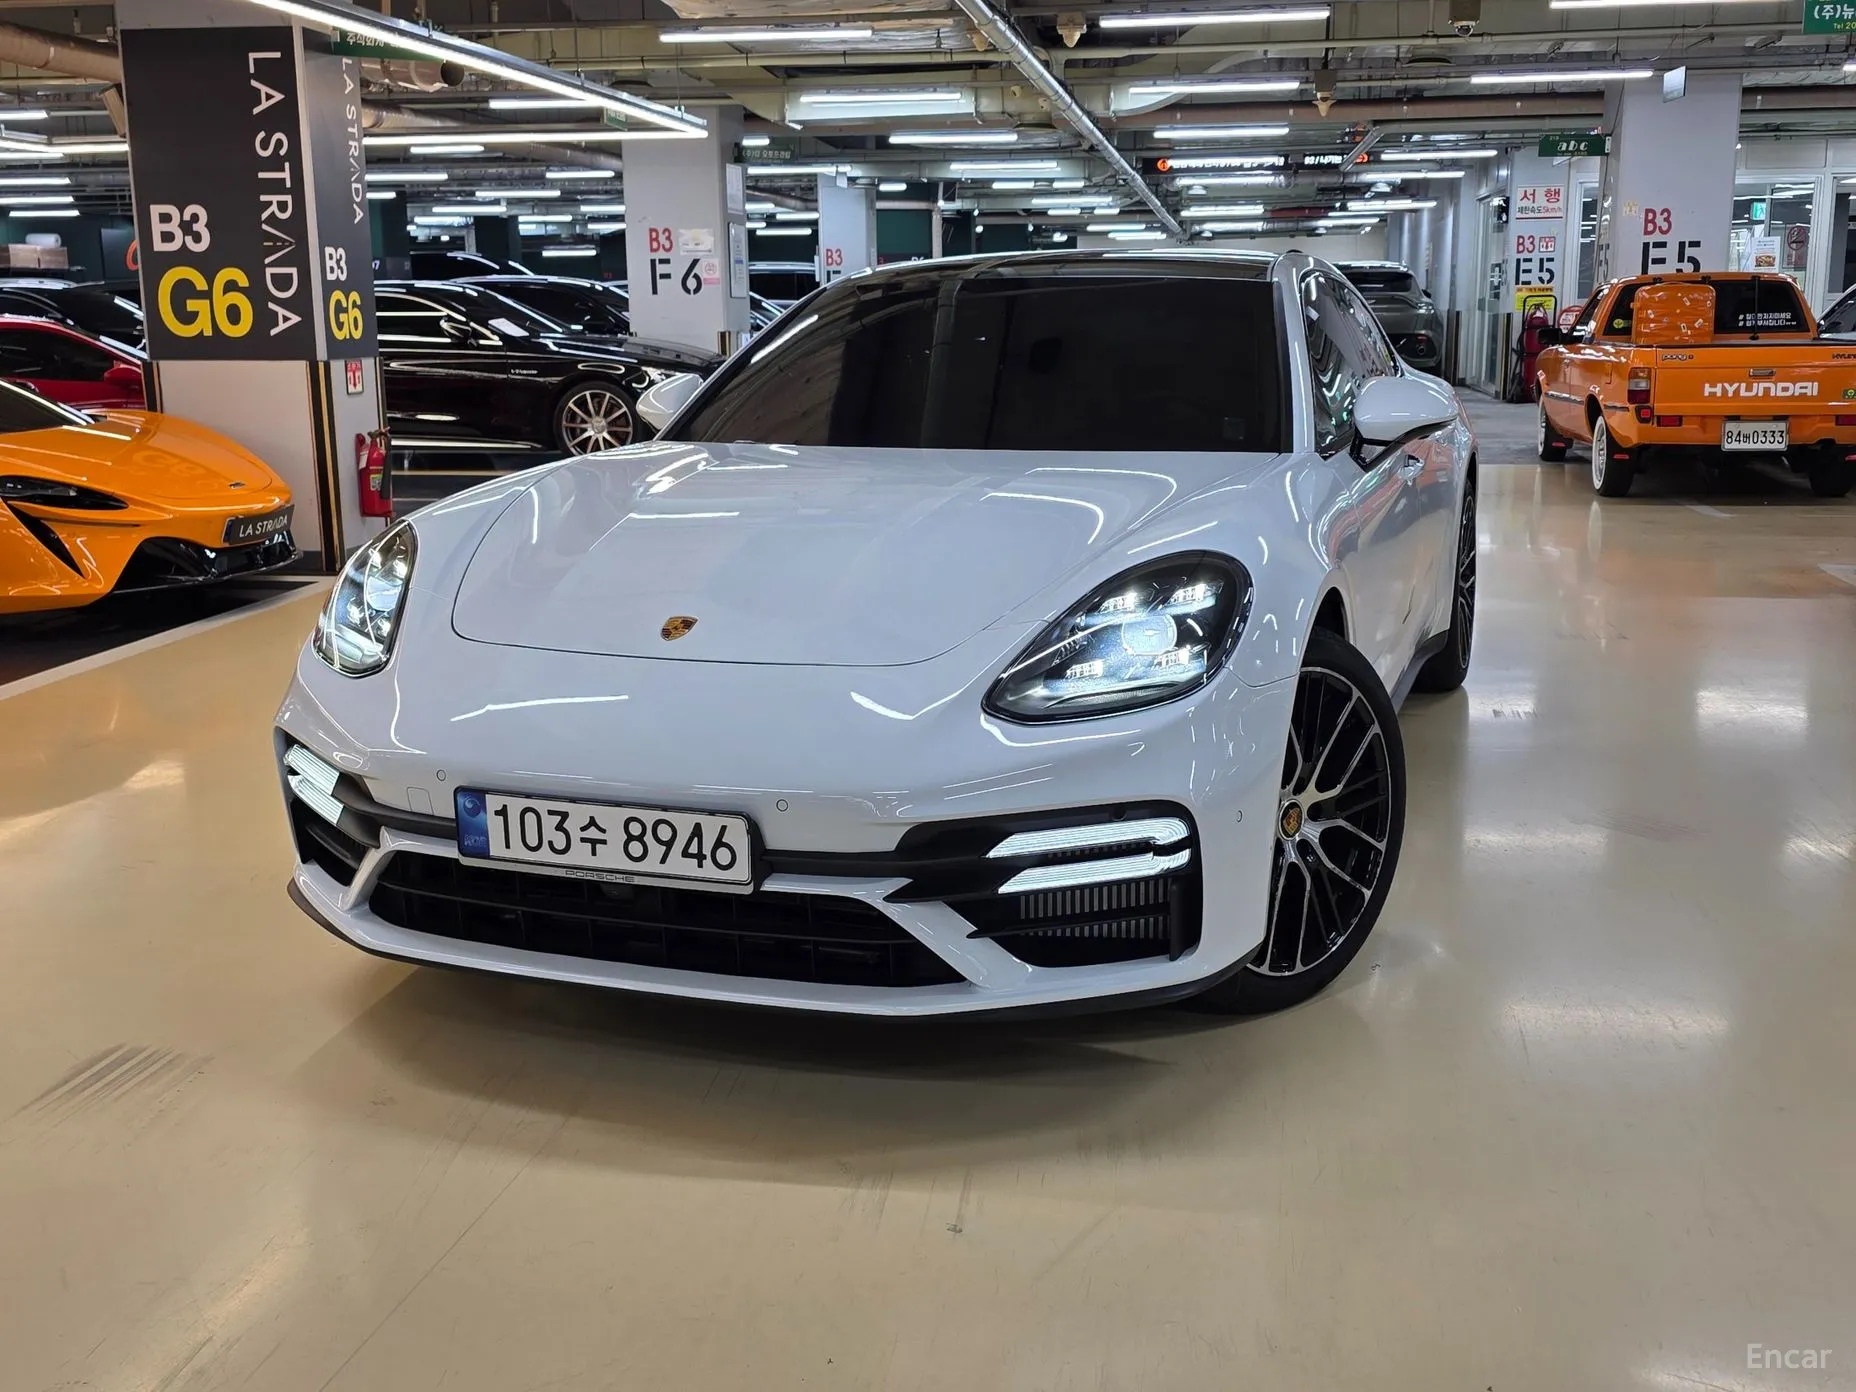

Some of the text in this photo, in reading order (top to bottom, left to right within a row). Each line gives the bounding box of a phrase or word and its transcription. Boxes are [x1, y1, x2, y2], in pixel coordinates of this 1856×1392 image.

[1813, 3, 1856, 20] (주)뉴
[1833, 22, 1844, 30] Tel
[341, 57, 364, 225] LA STRADA
[1557, 140, 1589, 152] abc
[248, 50, 303, 337] LA STRADA
[149, 203, 212, 253] B3
[1643, 208, 1672, 235] B3
[649, 227, 673, 253] B3
[1516, 235, 1536, 254] B3
[325, 245, 348, 282] B3
[825, 248, 843, 266] B3
[1515, 257, 1555, 285] E5
[157, 266, 254, 338] G6
[328, 289, 364, 341] G6
[1704, 382, 1818, 397] HYUNDAI
[239, 515, 288, 538] LA STRADA
[494, 803, 738, 872] 103수 8946
[564, 869, 636, 884] PORSCHE
